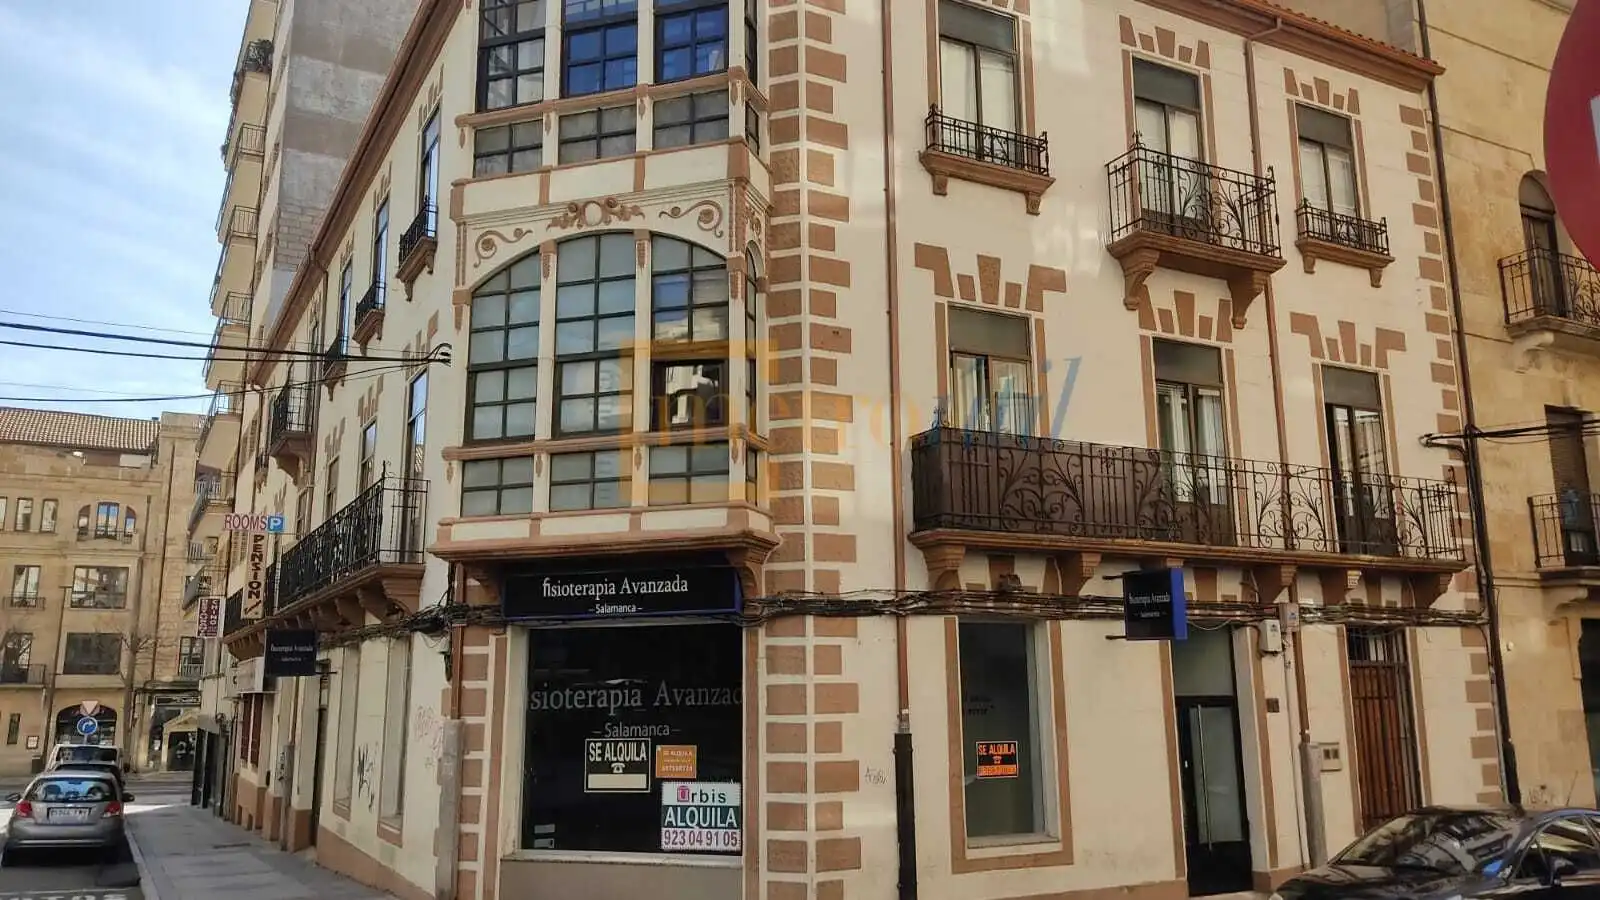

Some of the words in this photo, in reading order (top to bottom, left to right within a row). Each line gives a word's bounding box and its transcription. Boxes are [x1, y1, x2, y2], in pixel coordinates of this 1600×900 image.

[224, 514, 267, 531] ROOMS
[543, 577, 616, 600] fisioterapia
[619, 574, 688, 594] Avanzada
[595, 603, 636, 614] Salamanca
[604, 721, 670, 738] Salamanca
[588, 742, 602, 762] SE
[604, 742, 647, 762] ALQUILA
[978, 744, 987, 755] SE
[988, 743, 1016, 755] ALQUILA
[664, 806, 737, 829] ALQUILA
[664, 830, 686, 846] 923
[688, 830, 703, 846] 04
[705, 831, 719, 847] 91
[723, 831, 738, 847] 05
